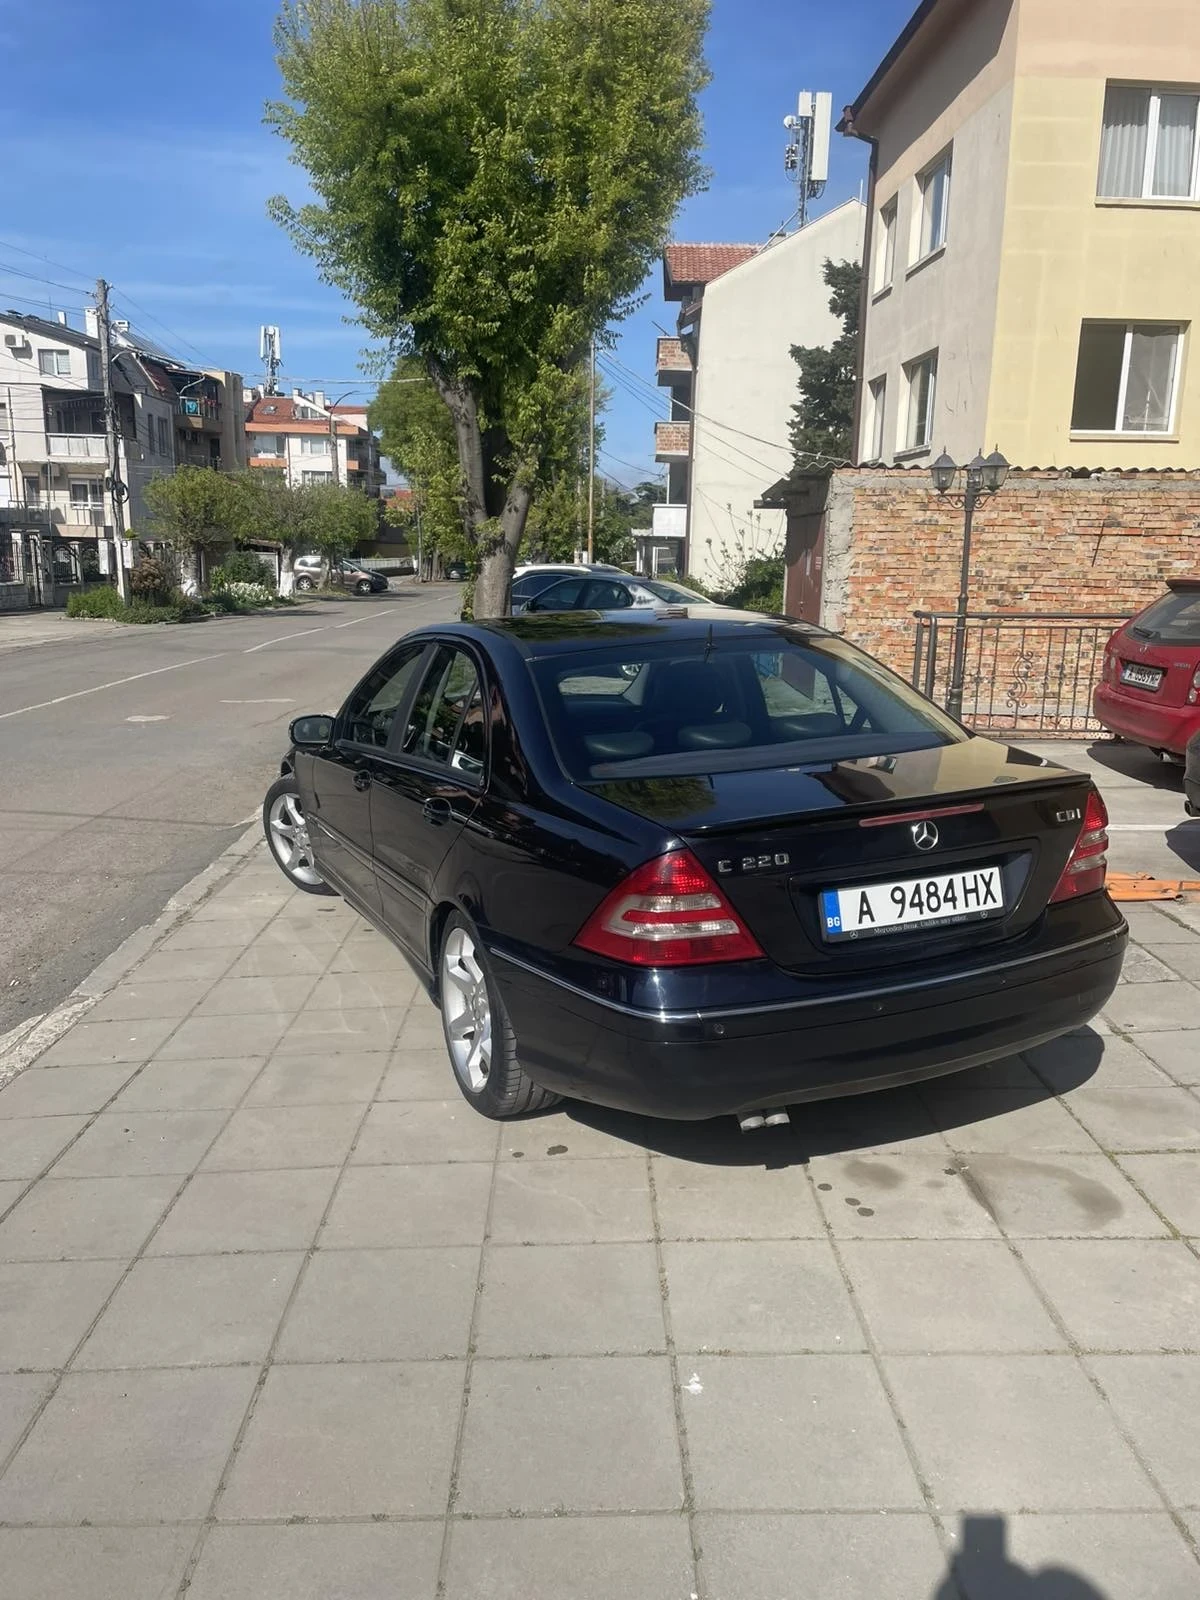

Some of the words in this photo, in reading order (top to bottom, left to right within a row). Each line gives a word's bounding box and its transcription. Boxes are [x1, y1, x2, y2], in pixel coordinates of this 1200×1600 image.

[1055, 808, 1081, 823] CDI
[718, 859, 732, 873] C
[742, 852, 790, 870] 220
[858, 891, 875, 924] A
[890, 878, 957, 919] 9484
[962, 871, 997, 908] HX
[827, 916, 840, 928] BG
